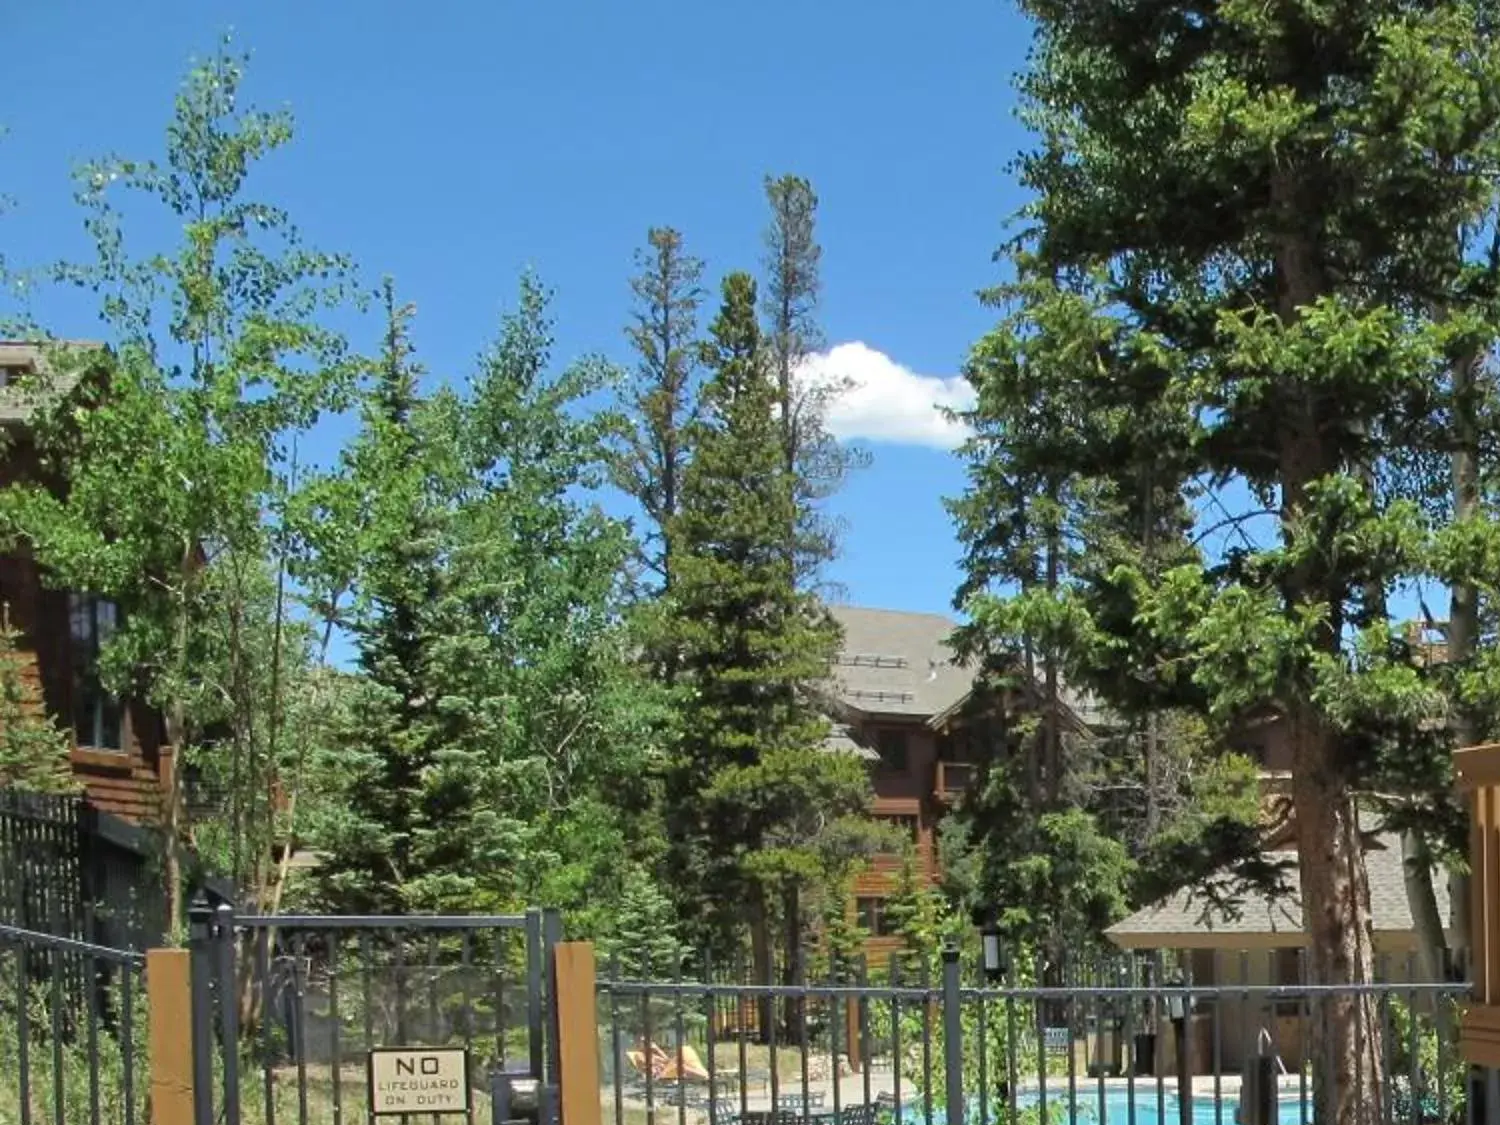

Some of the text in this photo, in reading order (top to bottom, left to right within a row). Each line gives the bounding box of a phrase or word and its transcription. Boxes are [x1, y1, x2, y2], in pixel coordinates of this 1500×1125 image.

[396, 1057, 439, 1075] NO
[378, 1079, 459, 1091] LIFEGUARD
[385, 1094, 451, 1105] ON DUTY
